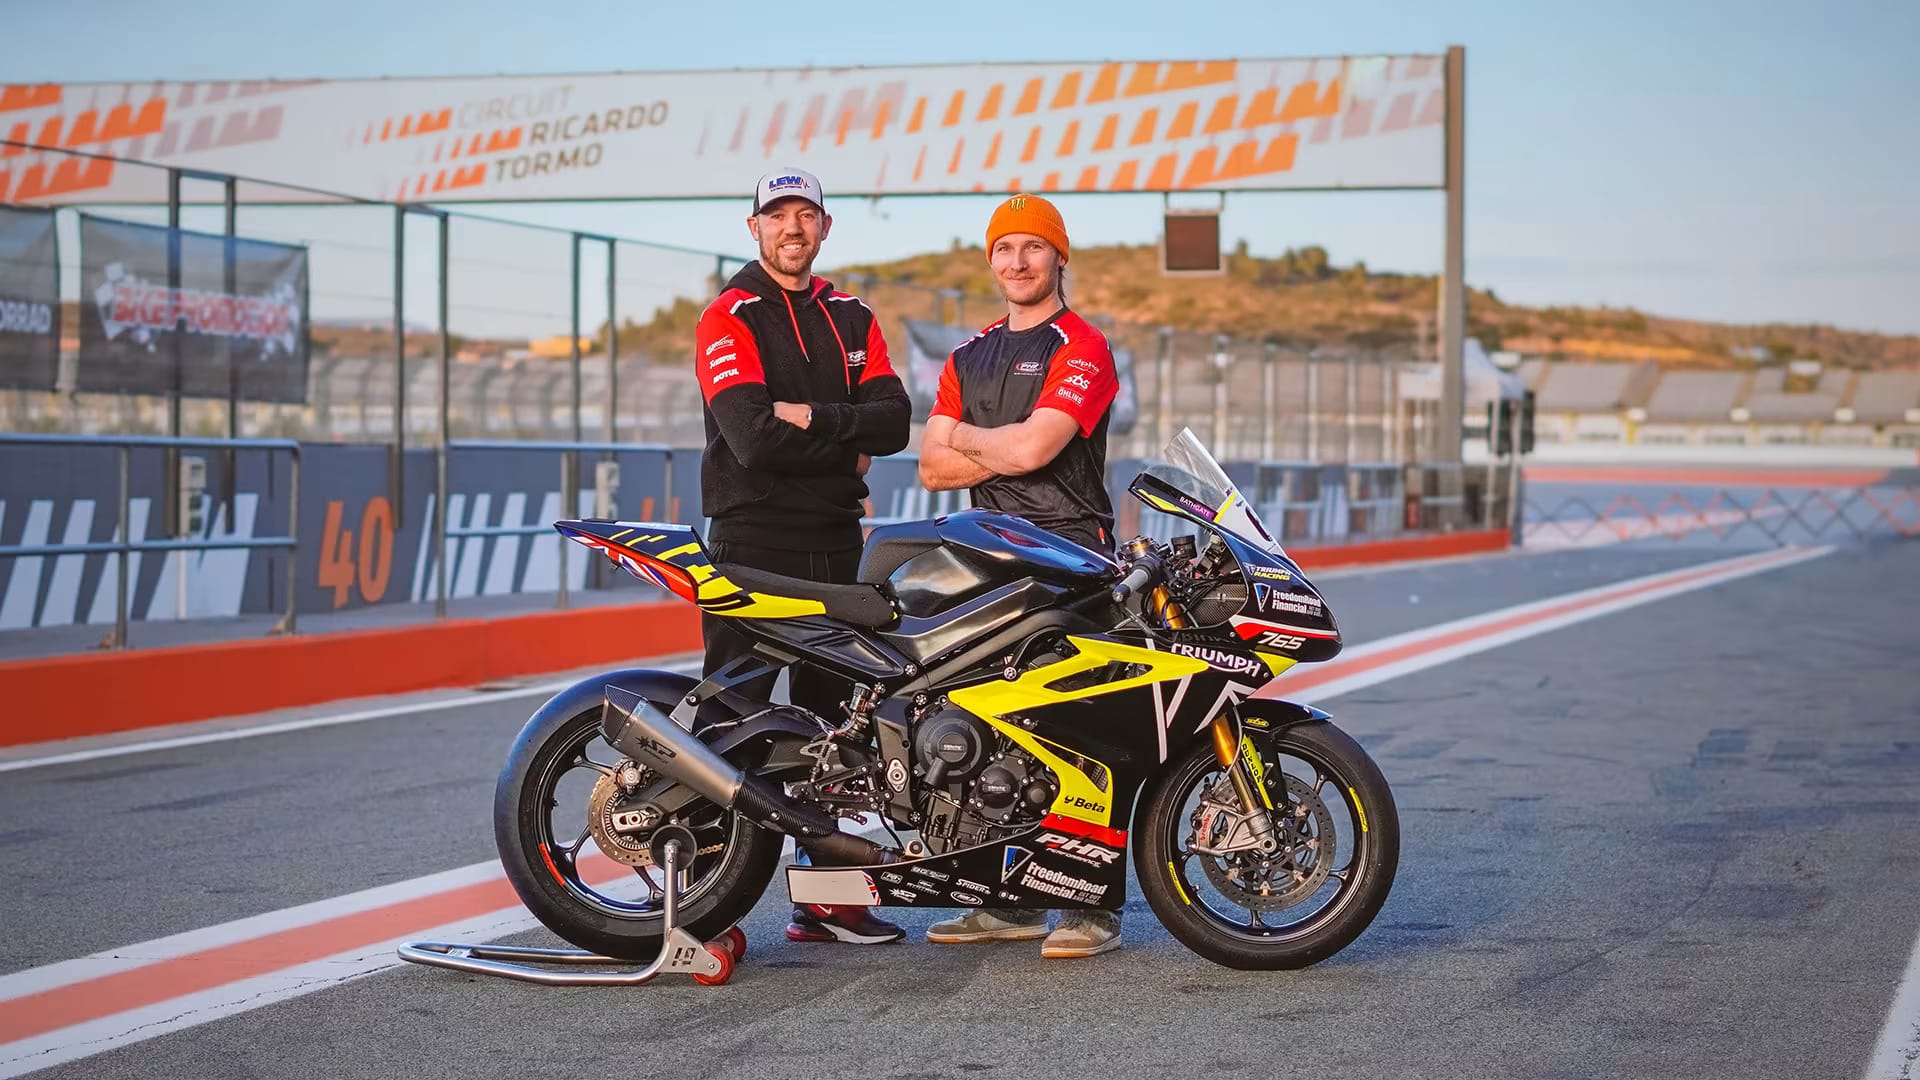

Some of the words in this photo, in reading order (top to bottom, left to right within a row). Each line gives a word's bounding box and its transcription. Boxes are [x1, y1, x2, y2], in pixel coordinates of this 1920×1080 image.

[458, 84, 575, 129] CIRCUIT
[529, 101, 669, 145] RICARDO
[495, 143, 604, 182] TORMO
[769, 176, 801, 189] LEW
[1180, 496, 1211, 518] BATHGATE
[317, 497, 393, 608] 40
[1254, 573, 1290, 581] RACING
[1256, 566, 1291, 576] TRIUMPH
[1272, 600, 1307, 614] Financial
[1273, 590, 1322, 608] FreedomRoad
[1257, 631, 1307, 650] 765
[1171, 643, 1261, 678] TRIUMPH
[1074, 797, 1106, 813] Beta
[1035, 833, 1121, 864] PHR
[955, 878, 985, 894] SPIDER
[1020, 874, 1077, 900] Financial
[1026, 861, 1109, 896] FreedomRoad
